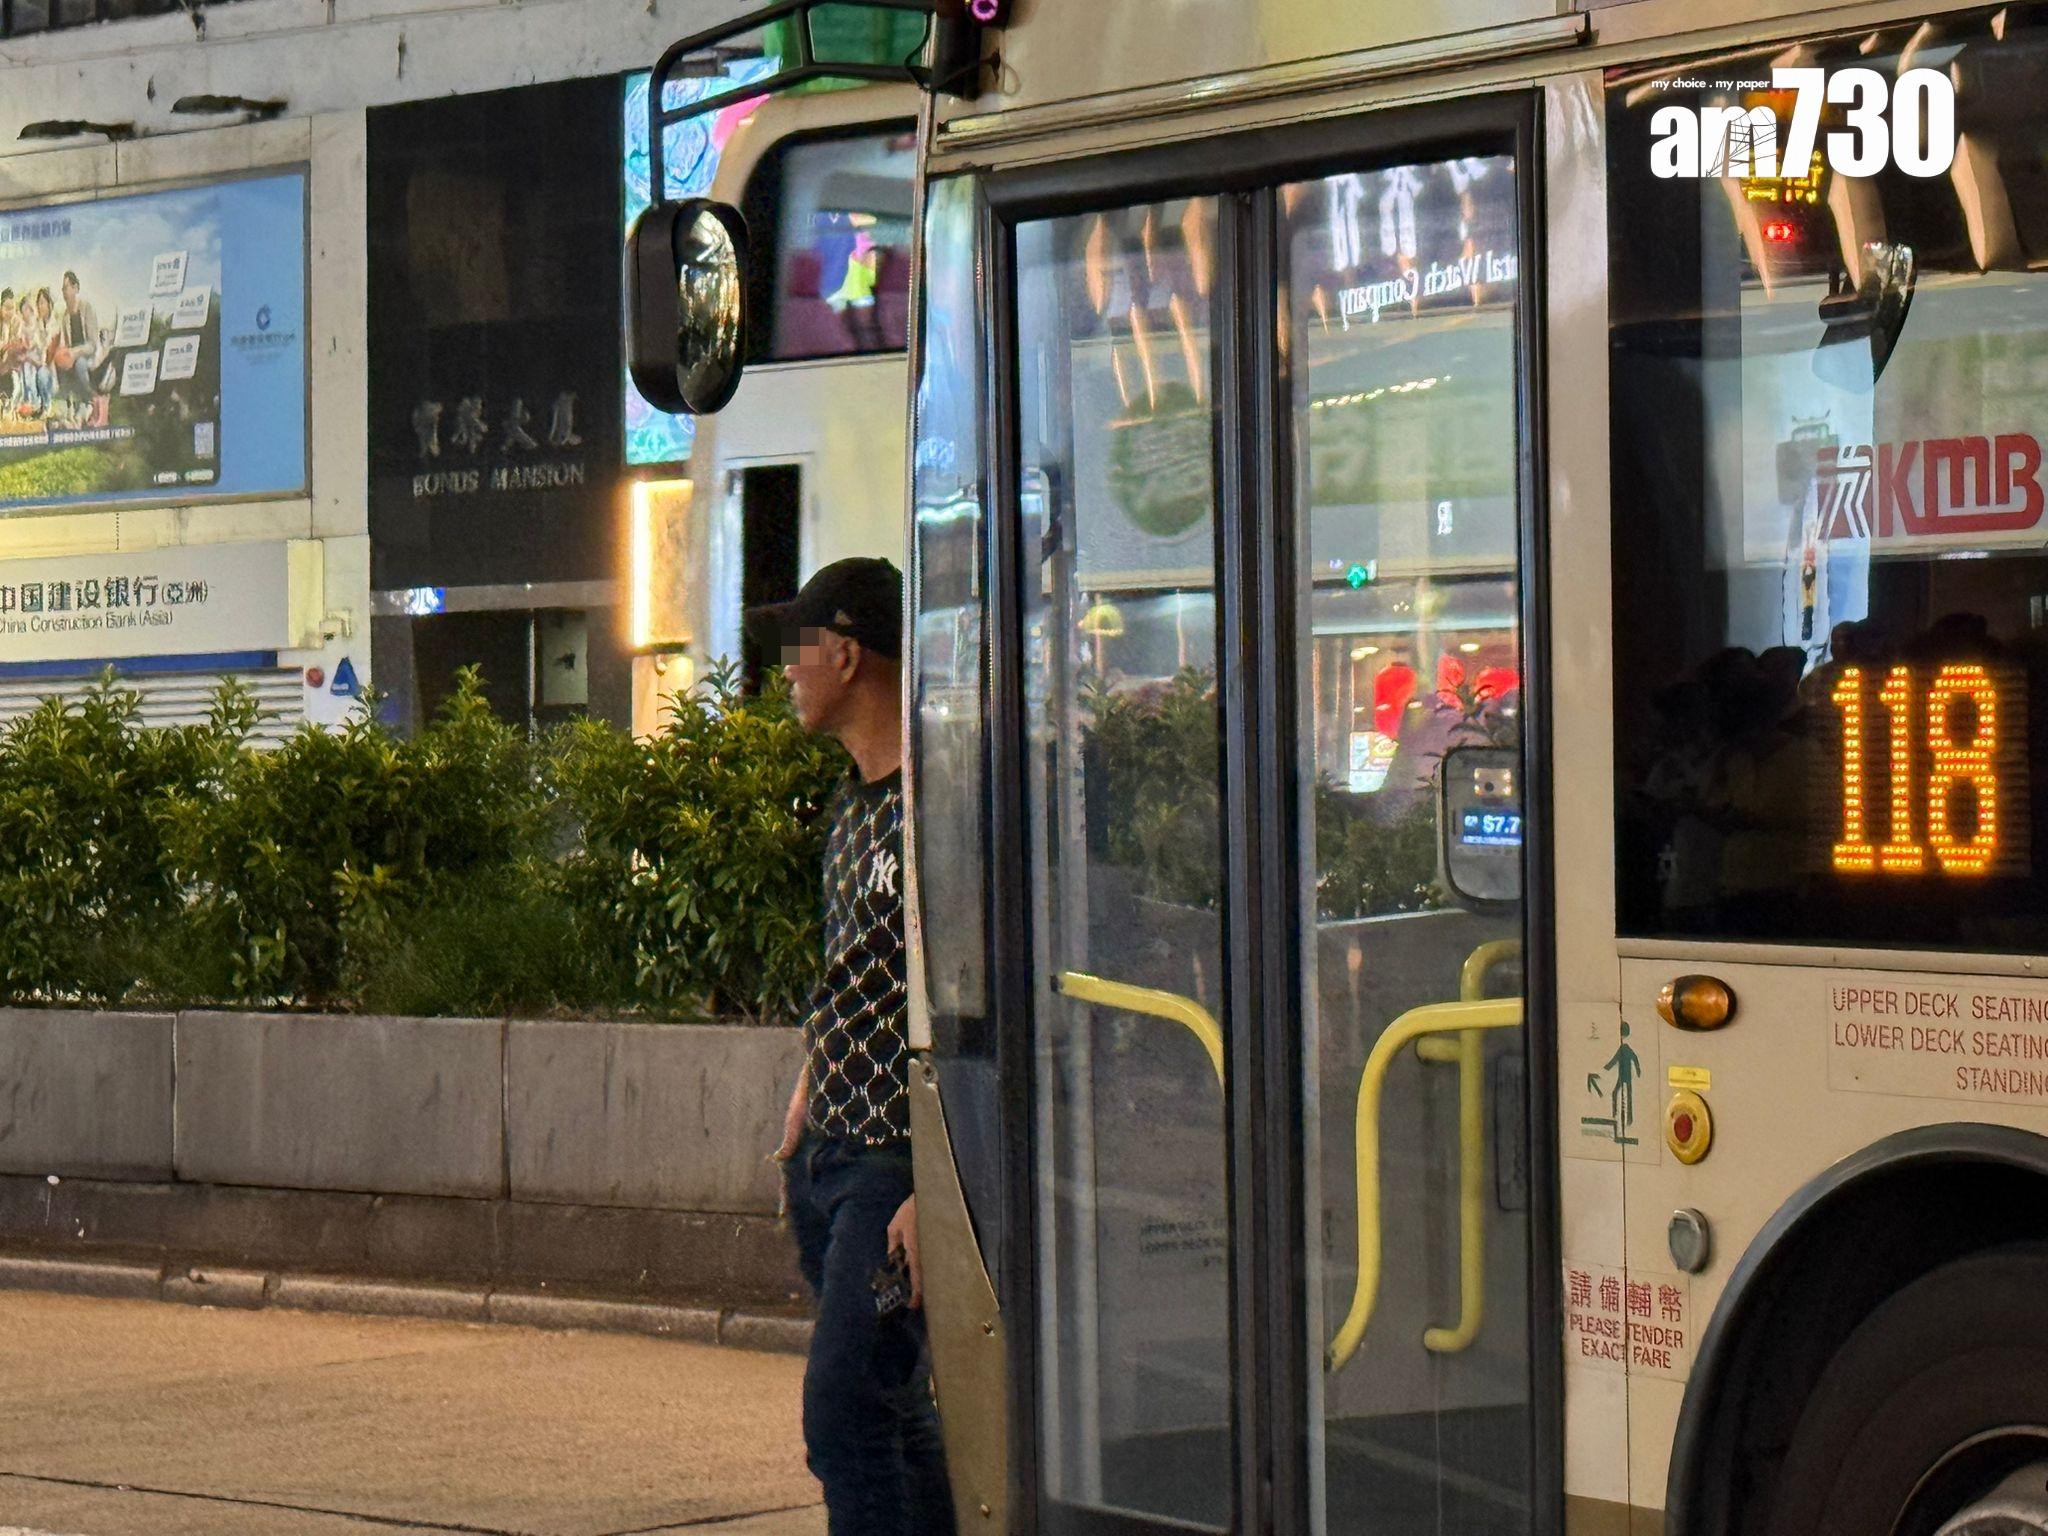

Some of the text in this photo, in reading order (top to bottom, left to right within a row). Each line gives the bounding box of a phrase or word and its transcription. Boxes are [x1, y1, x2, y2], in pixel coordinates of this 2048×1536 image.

[413, 463, 585, 498] BONUS MANSION
[31, 612, 103, 633] Construction
[106, 610, 138, 629] Bank
[140, 609, 173, 626] (Asia)
[1832, 664, 1996, 869] 118
[1833, 986, 1898, 1014] UPPER
[1905, 991, 1960, 1019] DECK
[1834, 1022, 1904, 1050] LOWER
[1911, 1026, 1966, 1055] DECK
[1570, 1313, 1683, 1349] PLEASE TENDER
[1633, 1345, 1671, 1369] FARE
